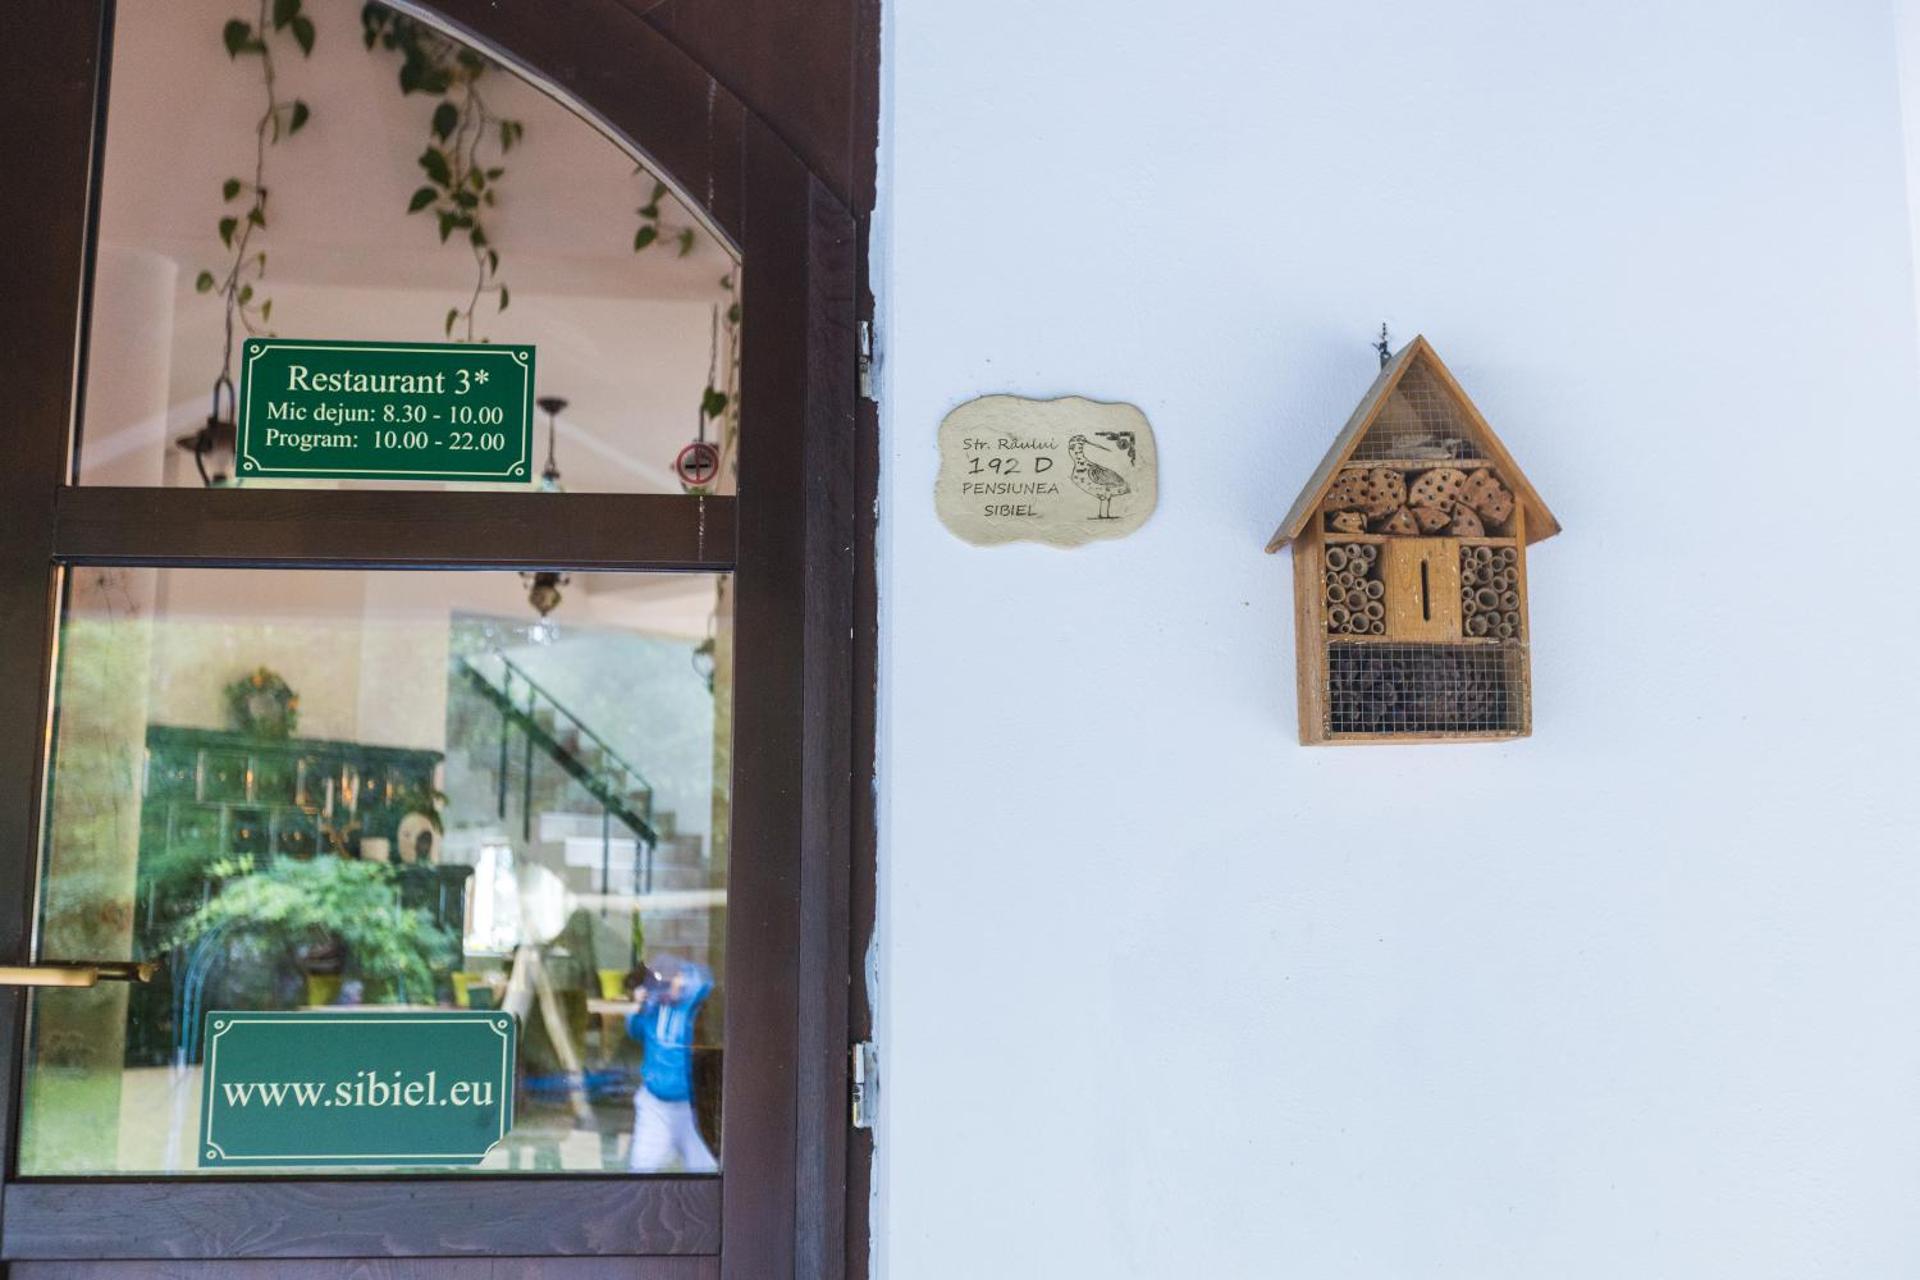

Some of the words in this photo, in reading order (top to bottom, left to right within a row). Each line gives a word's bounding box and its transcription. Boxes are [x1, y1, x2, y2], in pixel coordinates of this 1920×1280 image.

[287, 365, 446, 394] Restaurant
[266, 402, 307, 421] Mic
[313, 402, 376, 426] dejun:
[382, 404, 427, 423] 8.30
[450, 406, 504, 425] 10.00
[265, 428, 359, 452] Program:
[374, 431, 429, 449] 10.00
[449, 432, 506, 451] 22.00
[962, 438, 991, 451] Str.
[968, 457, 1021, 475] 192
[1034, 456, 1054, 474] D
[962, 481, 1060, 496] PENSIUNEA
[984, 504, 1038, 517] SIBIEL
[222, 1070, 494, 1108] www.sibiel.eu
